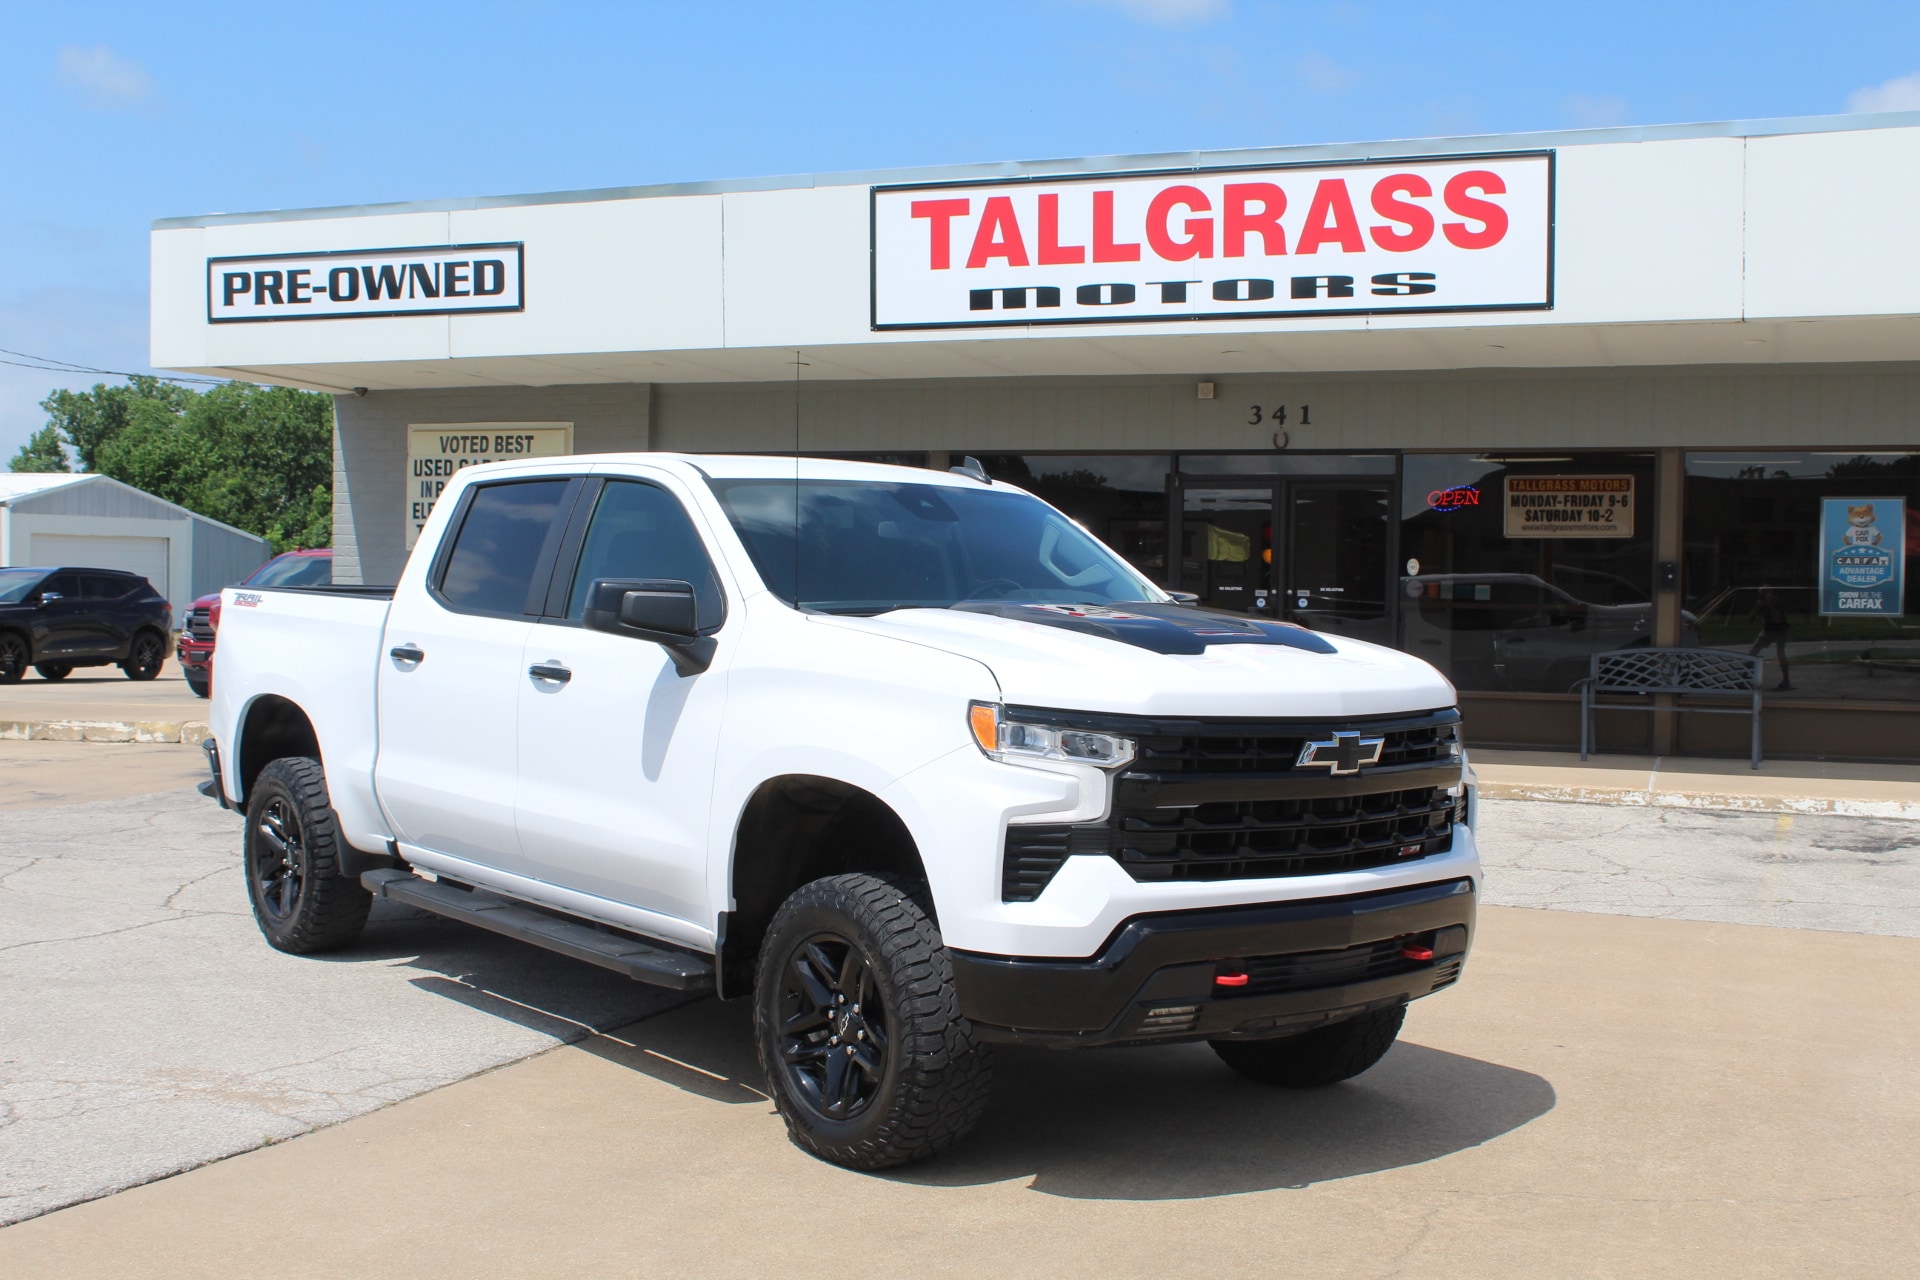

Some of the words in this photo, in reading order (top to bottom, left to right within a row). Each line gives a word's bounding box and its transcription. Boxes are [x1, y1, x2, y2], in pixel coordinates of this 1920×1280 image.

[910, 169, 1510, 271] TALLGRASS
[222, 259, 505, 307] PRE-OWNED
[1247, 404, 1312, 426] 341
[439, 435, 489, 454] VOTED
[494, 434, 534, 453] BEST
[413, 458, 453, 477] USED
[420, 480, 433, 498] IN
[1512, 480, 1576, 491] TALLGRASS
[1579, 479, 1628, 490] MOTORS
[1427, 489, 1480, 507] OPEN
[1510, 494, 1605, 508] MONDAY-FRIDAY
[1608, 494, 1629, 507] 9-6
[1525, 509, 1583, 522] SATURDAY
[1587, 509, 1614, 522] 10-2
[1521, 523, 1618, 532] www.tallgrassmotors.com
[1836, 556, 1888, 566] CARFAX
[1839, 567, 1885, 575] ADVANTAGE
[1846, 575, 1877, 583] DEALER
[234, 592, 264, 603] TRAIL
[1838, 591, 1859, 599] SHOW
[1838, 599, 1883, 609] CARFAX
